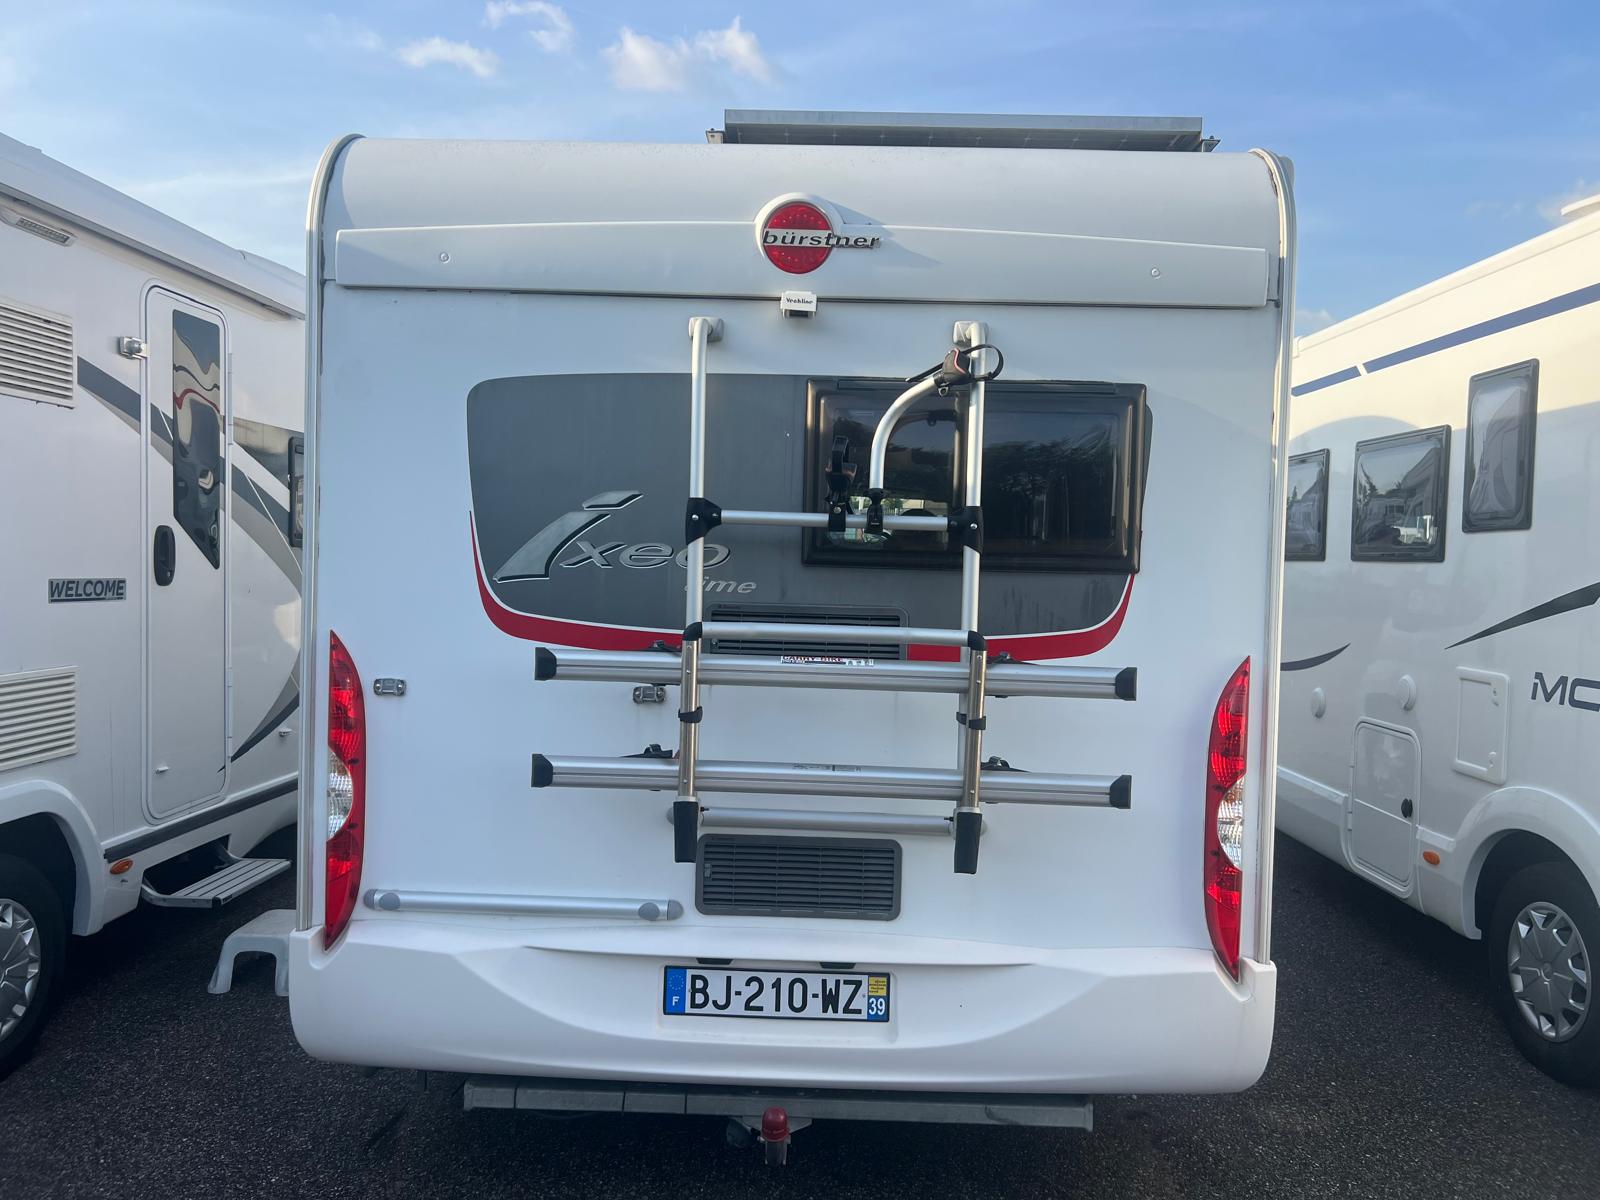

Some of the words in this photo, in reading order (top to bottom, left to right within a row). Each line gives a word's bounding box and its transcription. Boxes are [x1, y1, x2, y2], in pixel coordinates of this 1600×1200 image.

[763, 231, 880, 248] bürstner
[50, 580, 126, 598] WELCOME
[672, 996, 680, 1006] F
[690, 974, 863, 1014] BJ-210-WZ
[868, 998, 886, 1016] 39
